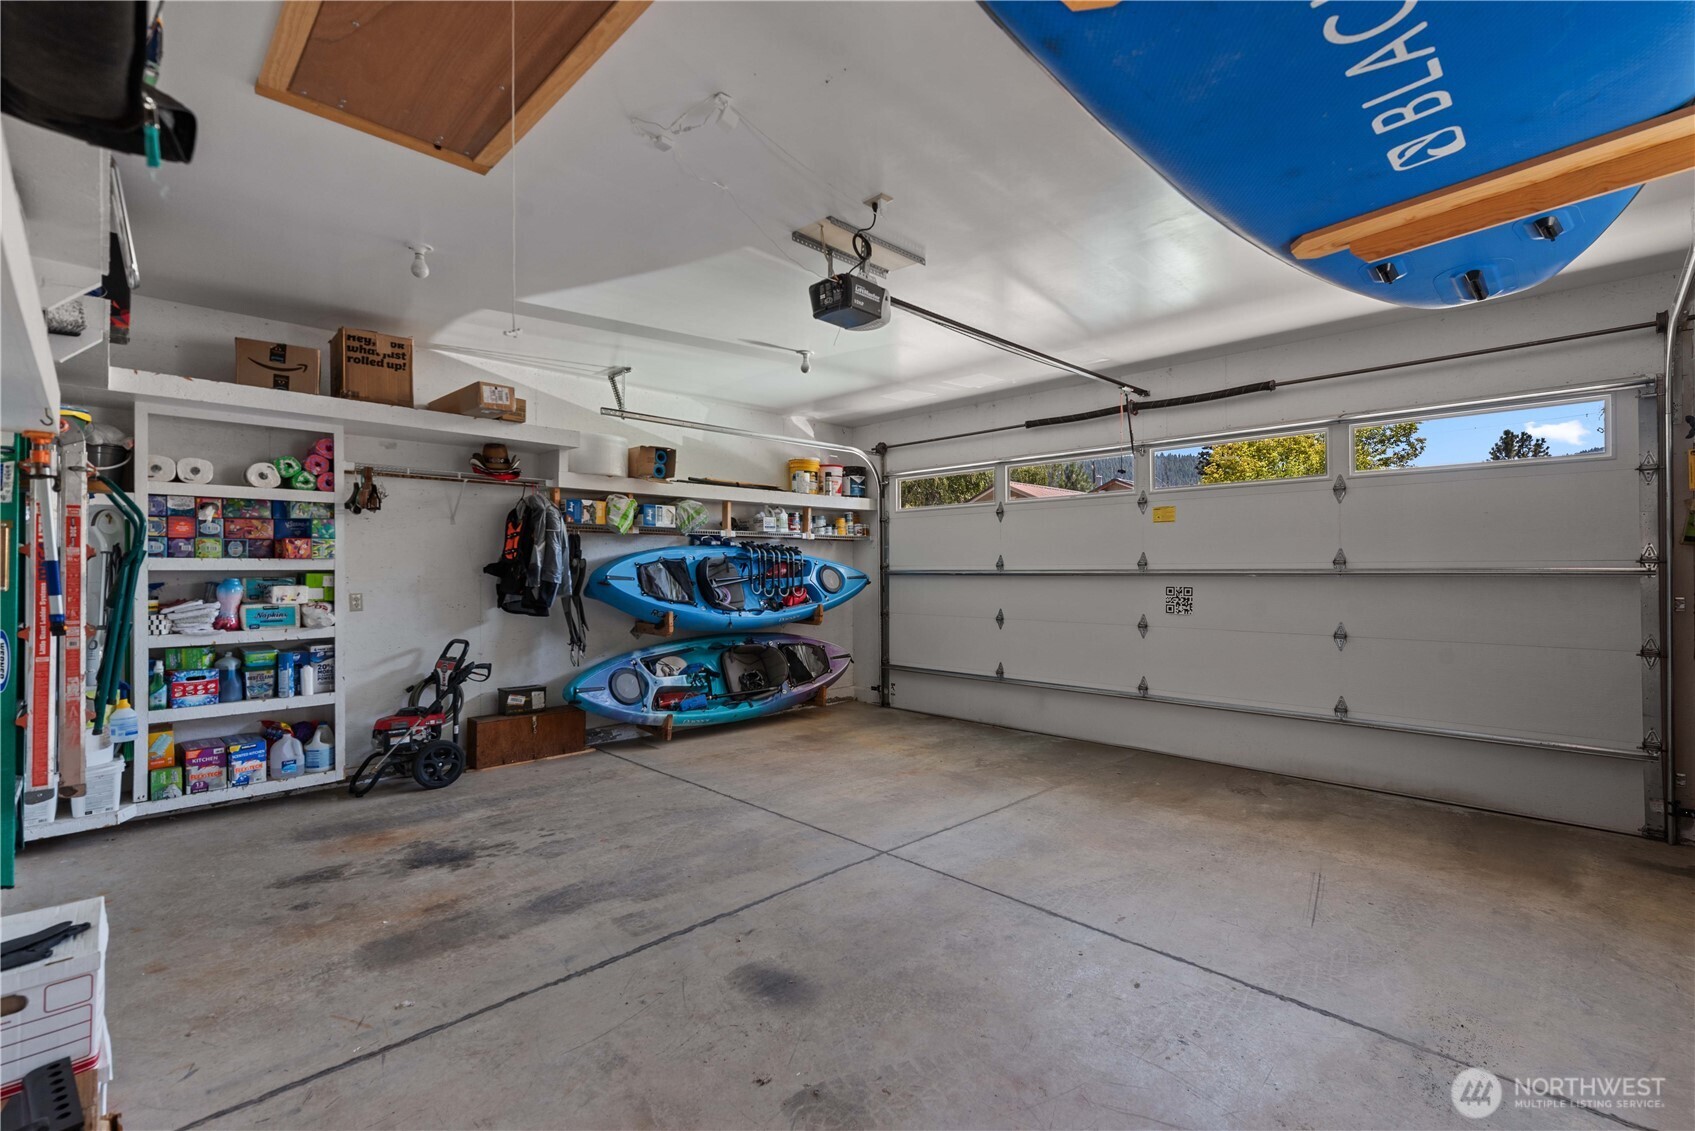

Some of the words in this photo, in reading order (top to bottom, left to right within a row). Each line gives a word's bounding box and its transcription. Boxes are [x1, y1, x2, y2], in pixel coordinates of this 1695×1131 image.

[1310, 0, 1453, 135] BLAC
[346, 355, 384, 368] rolled
[386, 361, 407, 372] up!
[254, 611, 288, 620] Napkins
[192, 756, 218, 764] KITCHEN
